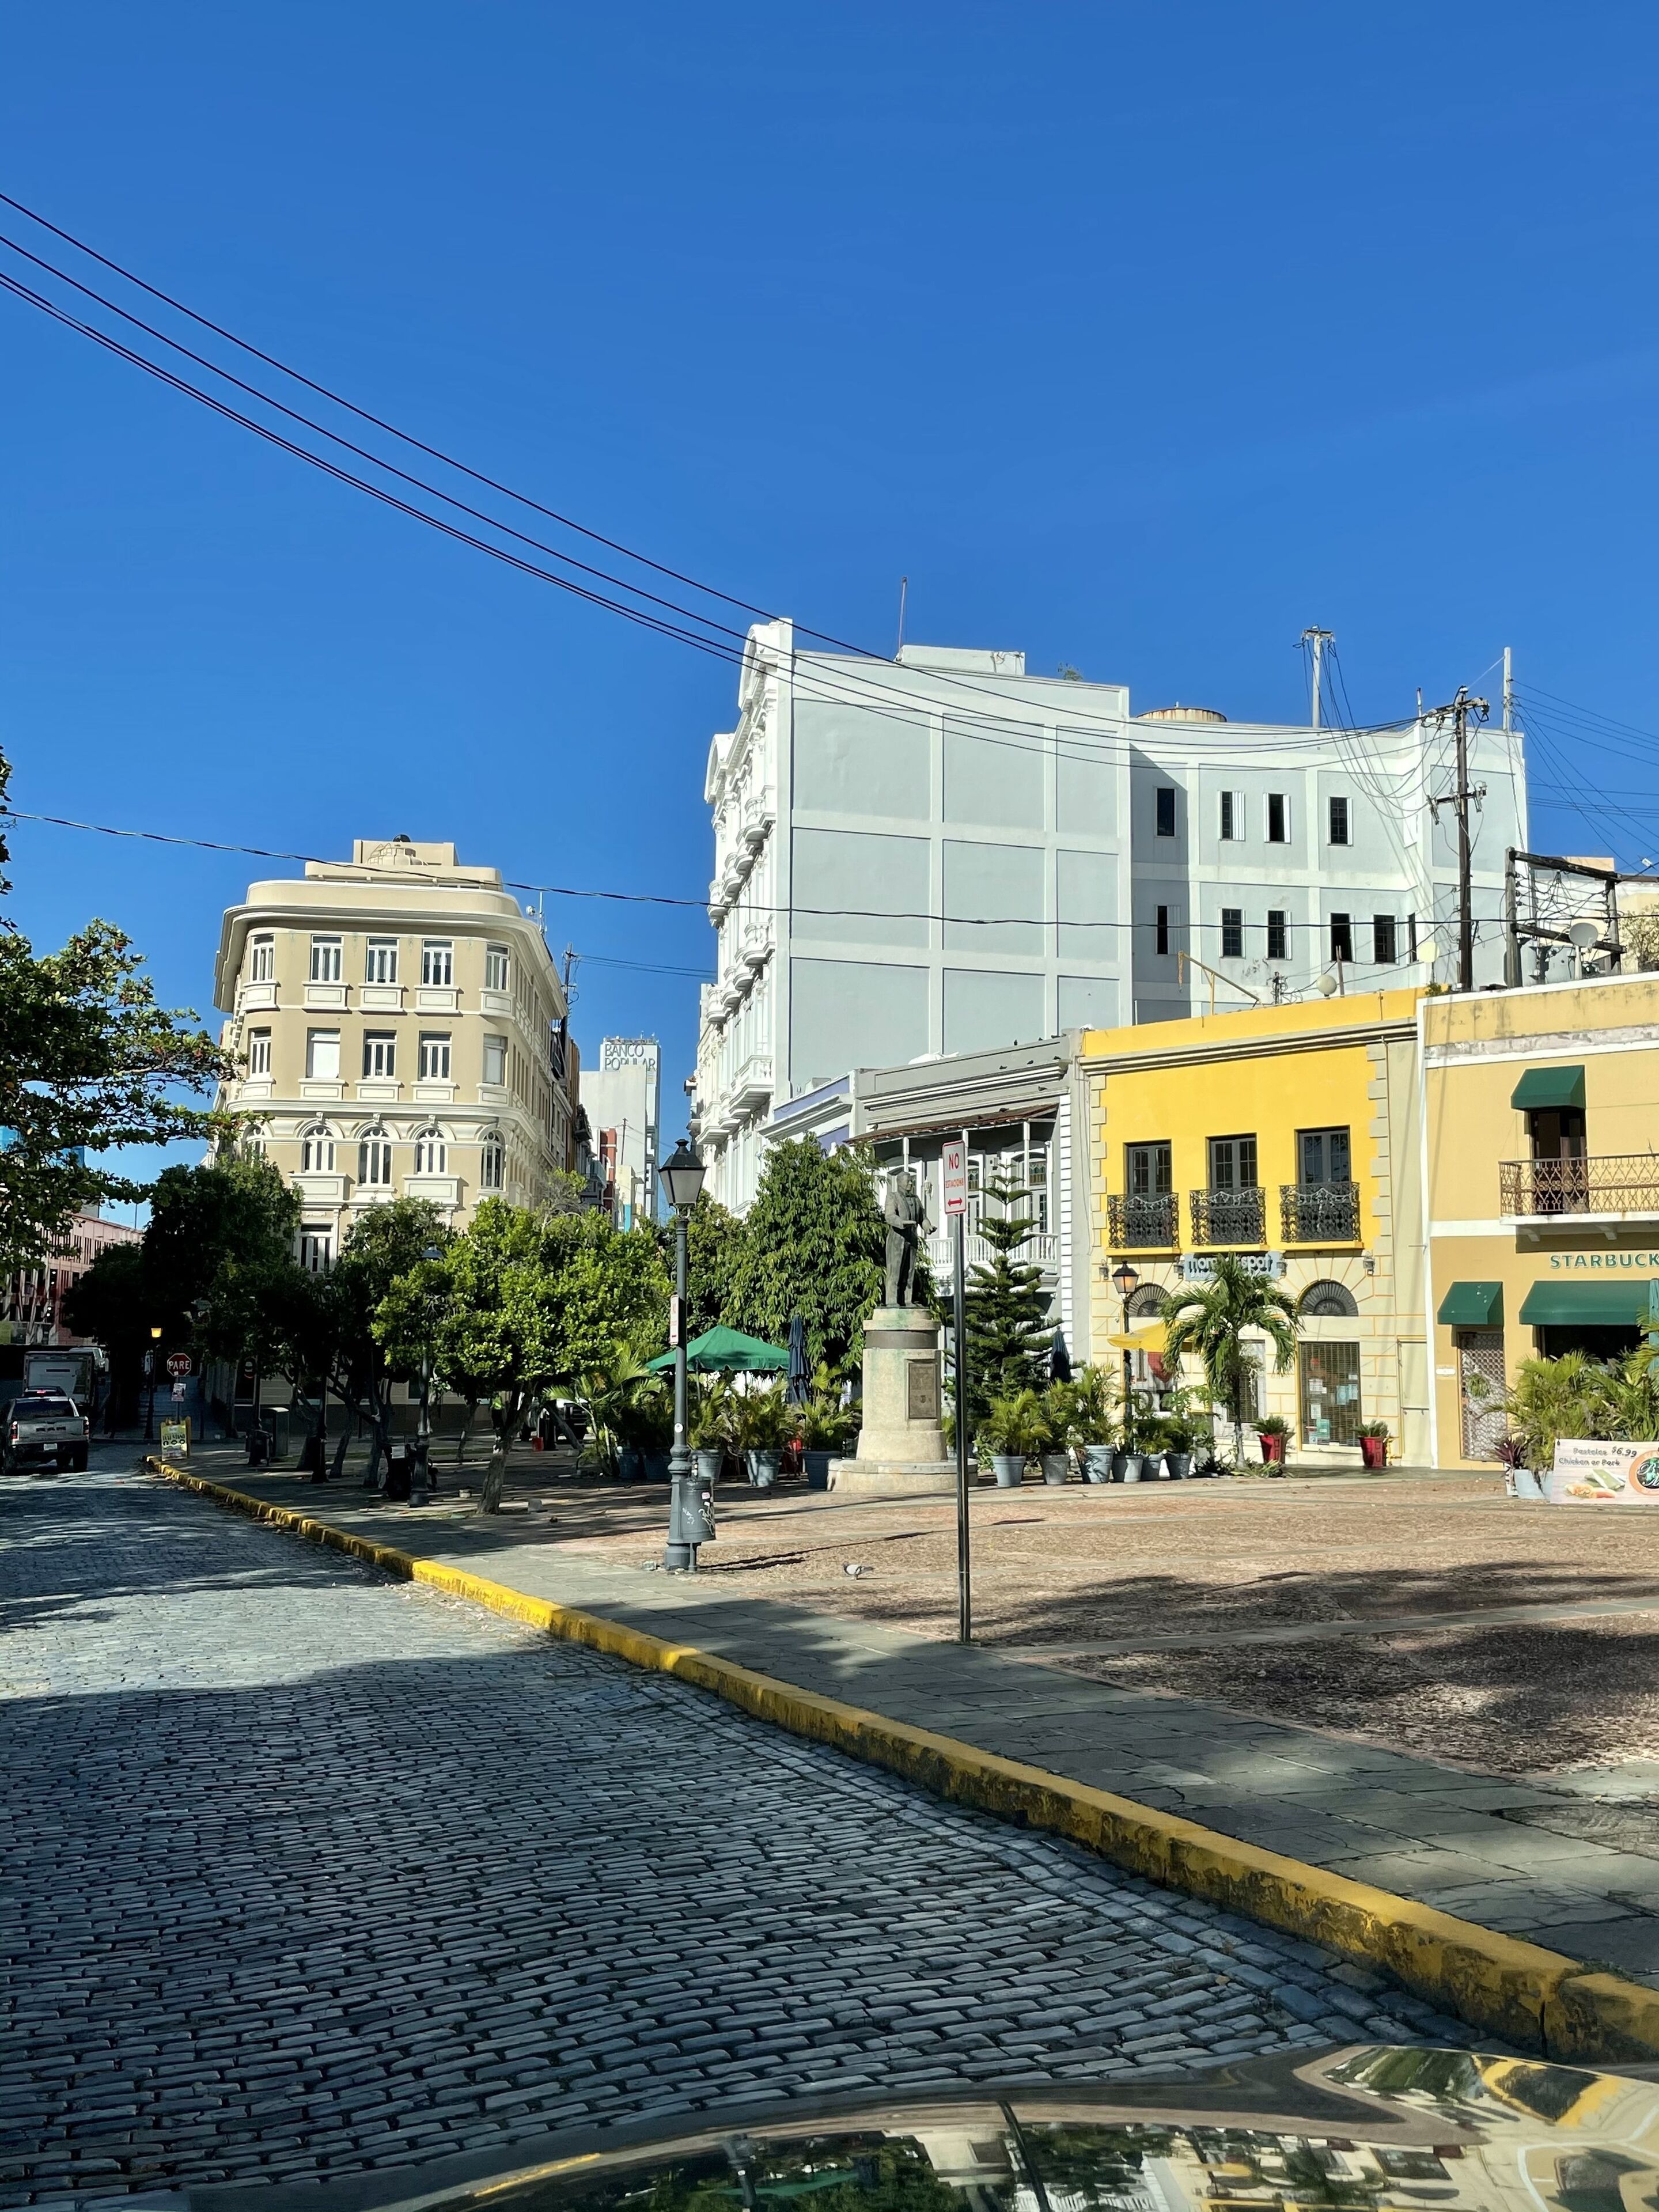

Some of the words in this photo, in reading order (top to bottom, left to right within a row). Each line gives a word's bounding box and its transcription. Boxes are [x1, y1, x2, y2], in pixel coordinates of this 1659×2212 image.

[605, 1044, 644, 1057] BANCO
[949, 1153, 959, 1170] NO
[169, 1361, 190, 1370] PARE
[1612, 1446, 1637, 1457] $6.99
[1559, 1457, 1589, 1465] Chicken
